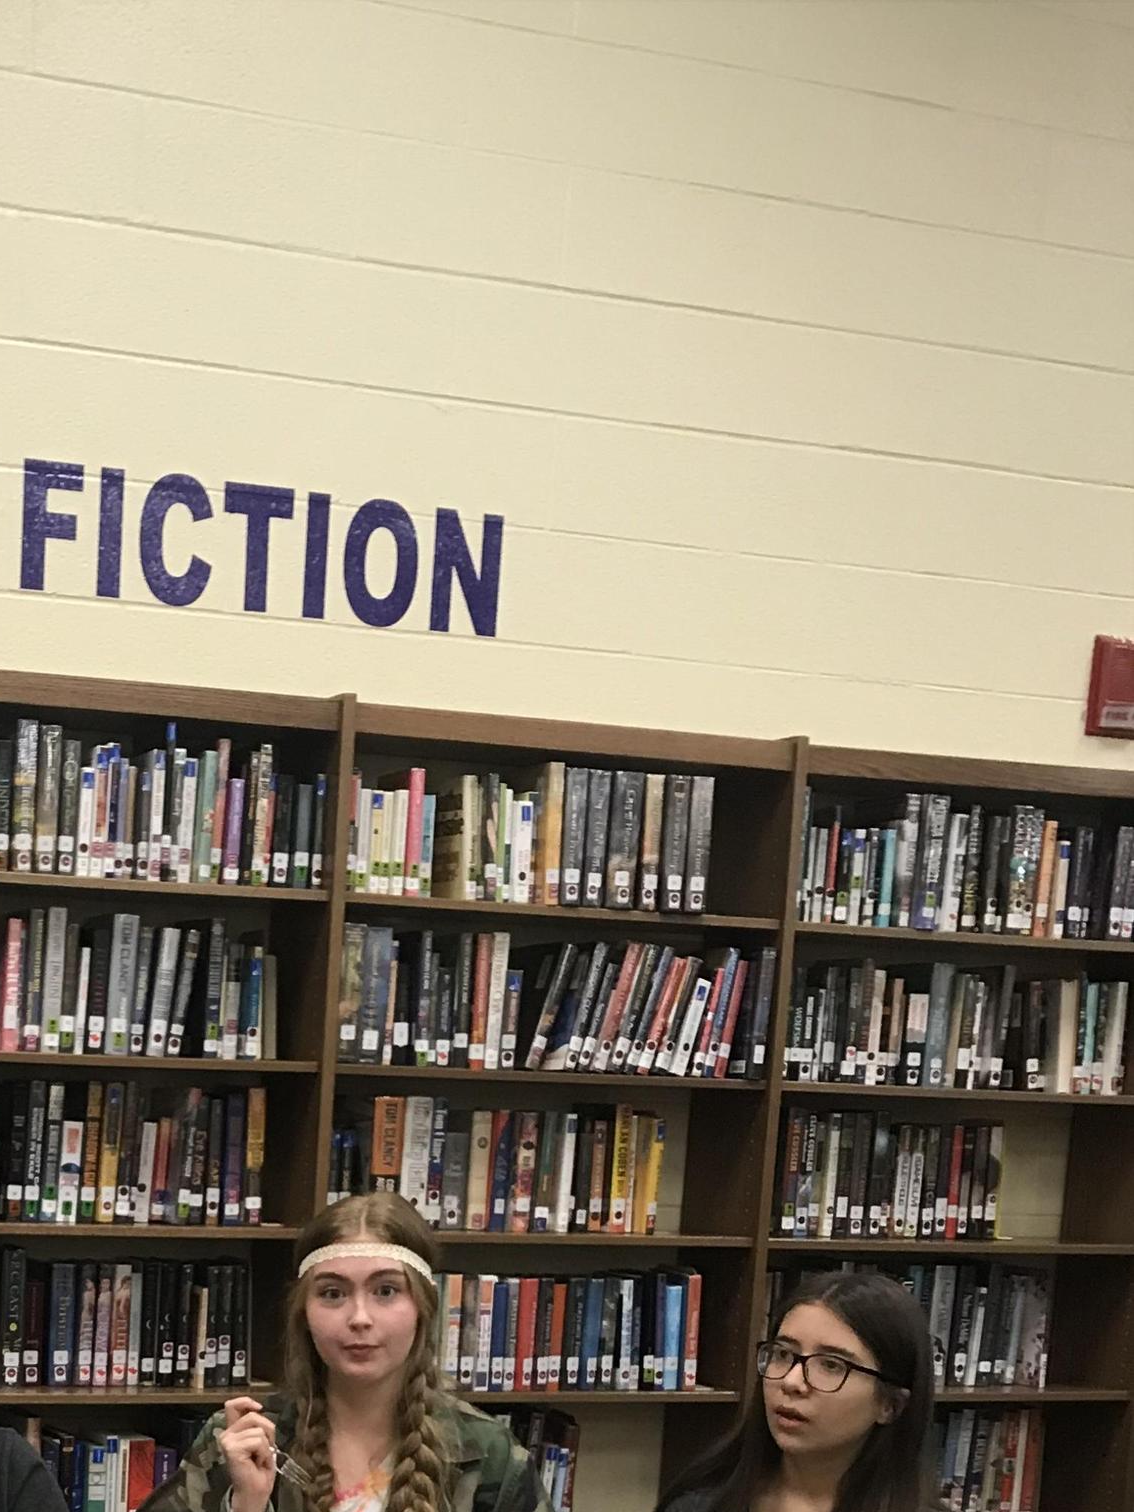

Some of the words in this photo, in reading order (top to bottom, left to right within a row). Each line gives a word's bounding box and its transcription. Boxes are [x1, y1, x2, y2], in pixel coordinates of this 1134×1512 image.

[20, 458, 505, 637] FICTION
[122, 921, 133, 946] TOM
[118, 948, 131, 996] CLANCY
[384, 1102, 398, 1124] TOM
[807, 1114, 817, 1138] CLIVE
[35, 1143, 43, 1172] SCOTT
[382, 1126, 397, 1168] CLANCY
[616, 1147, 627, 1178] COBEN
[788, 1136, 800, 1172] CUSSLER
[804, 1139, 815, 1172] CUSSLER
[28, 1154, 36, 1180] EXILE
[9, 1285, 19, 1320] CAST
